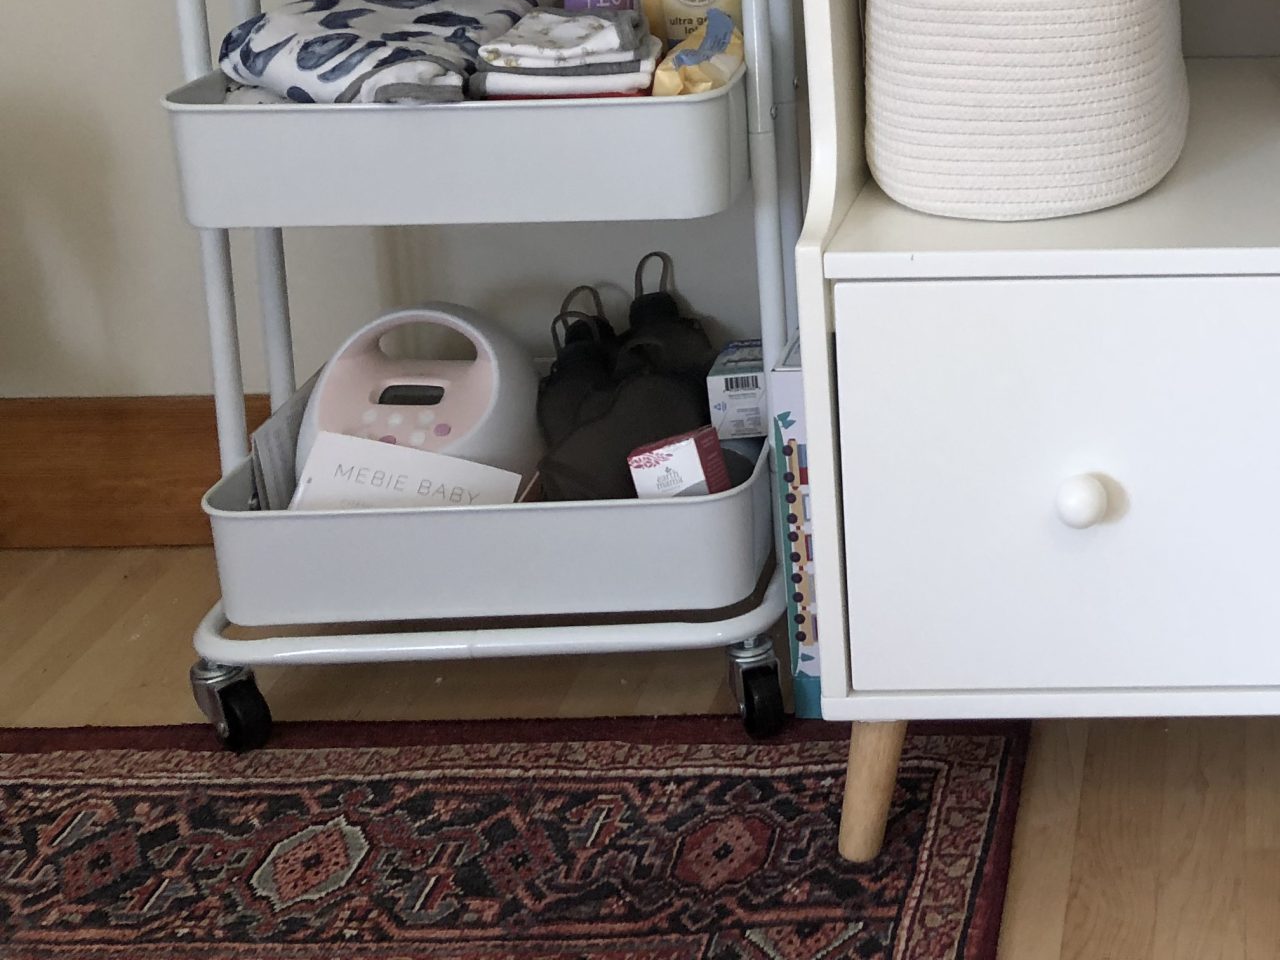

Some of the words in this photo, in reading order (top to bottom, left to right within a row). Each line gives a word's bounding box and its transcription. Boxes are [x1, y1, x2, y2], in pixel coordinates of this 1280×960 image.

[669, 17, 693, 26] ultra
[656, 476, 684, 490] mama
[657, 471, 680, 483] earth
[334, 463, 409, 492] MEBIE
[417, 479, 481, 505] BABY
